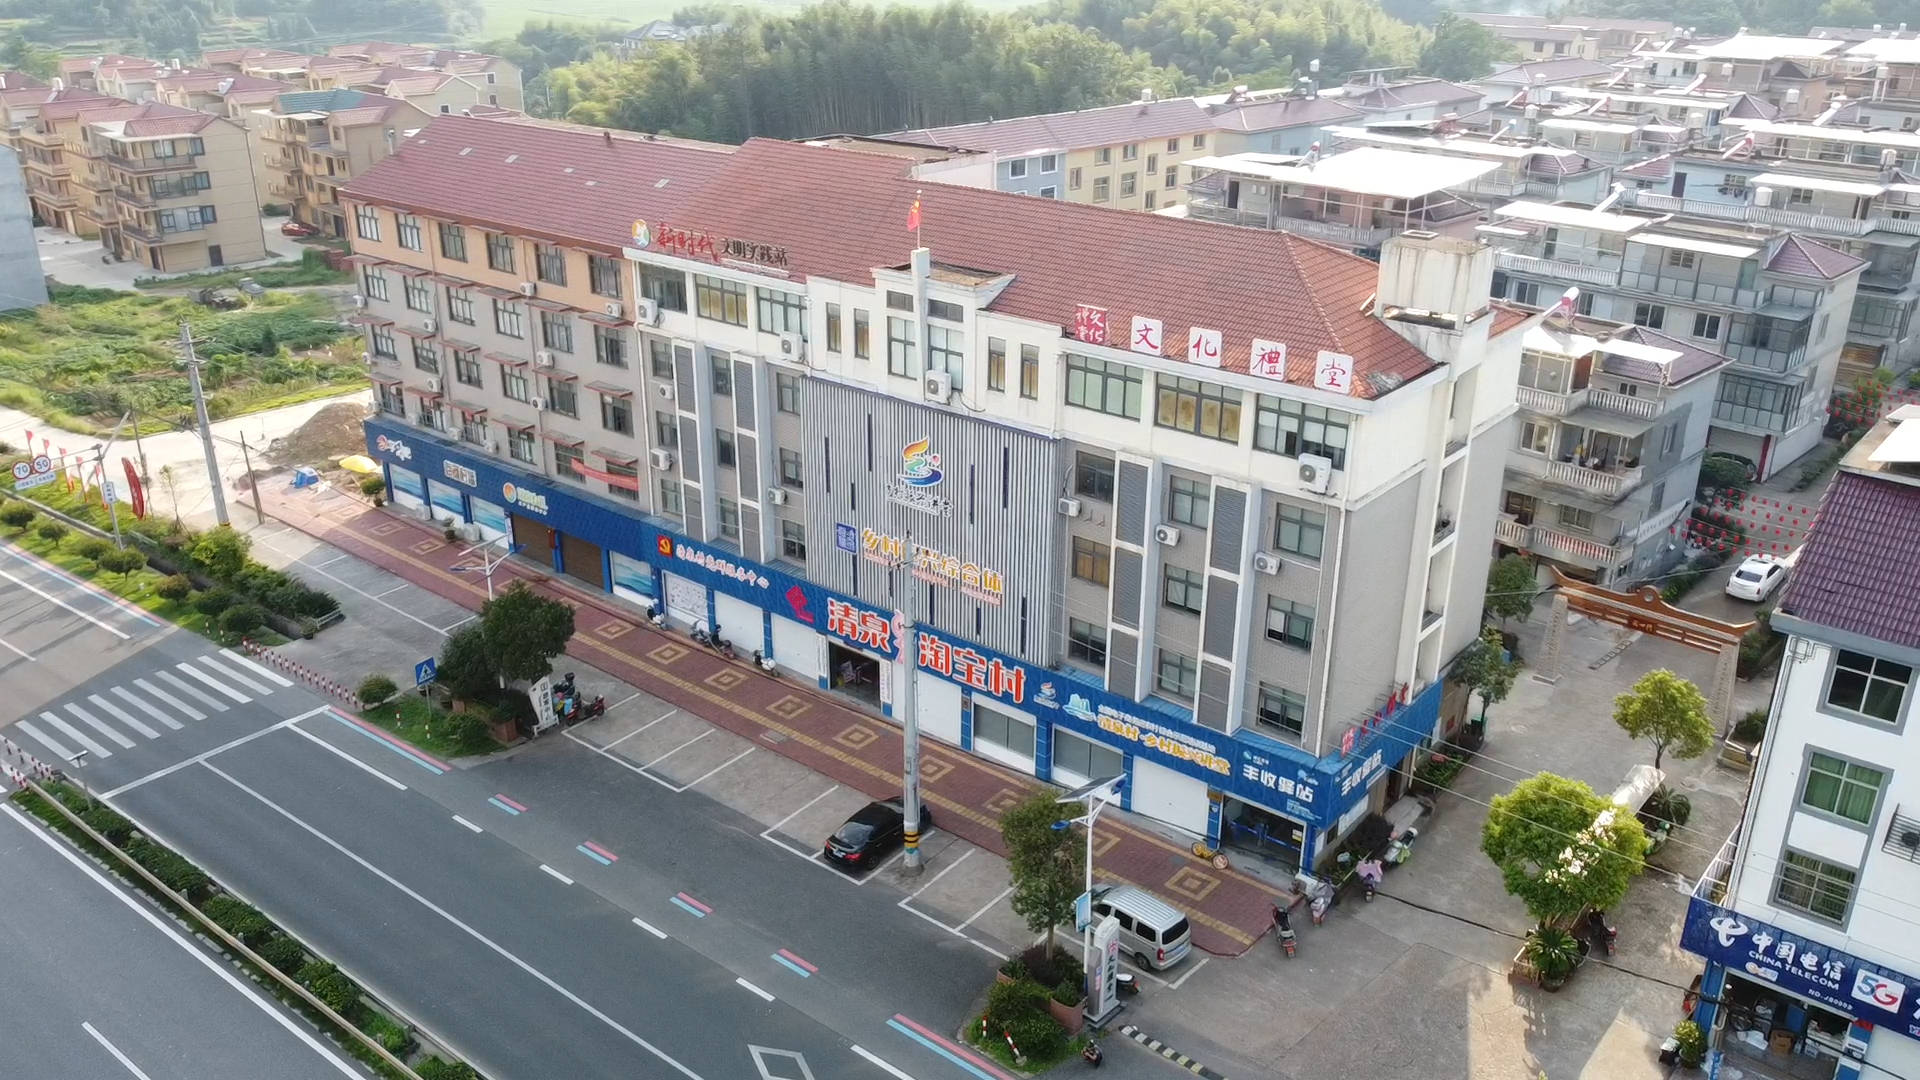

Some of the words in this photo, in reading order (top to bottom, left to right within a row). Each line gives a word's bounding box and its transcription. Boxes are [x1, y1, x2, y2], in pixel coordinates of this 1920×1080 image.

[17, 464, 29, 475] 70
[36, 459, 48, 470] 50
[827, 597, 892, 653] 清泉
[918, 632, 1027, 704] 淘宝村
[1748, 950, 1782, 969] CHINA
[1784, 964, 1840, 991] TELECOM
[1751, 931, 1847, 982] 中国电信
[1856, 974, 1900, 1007] 5G
